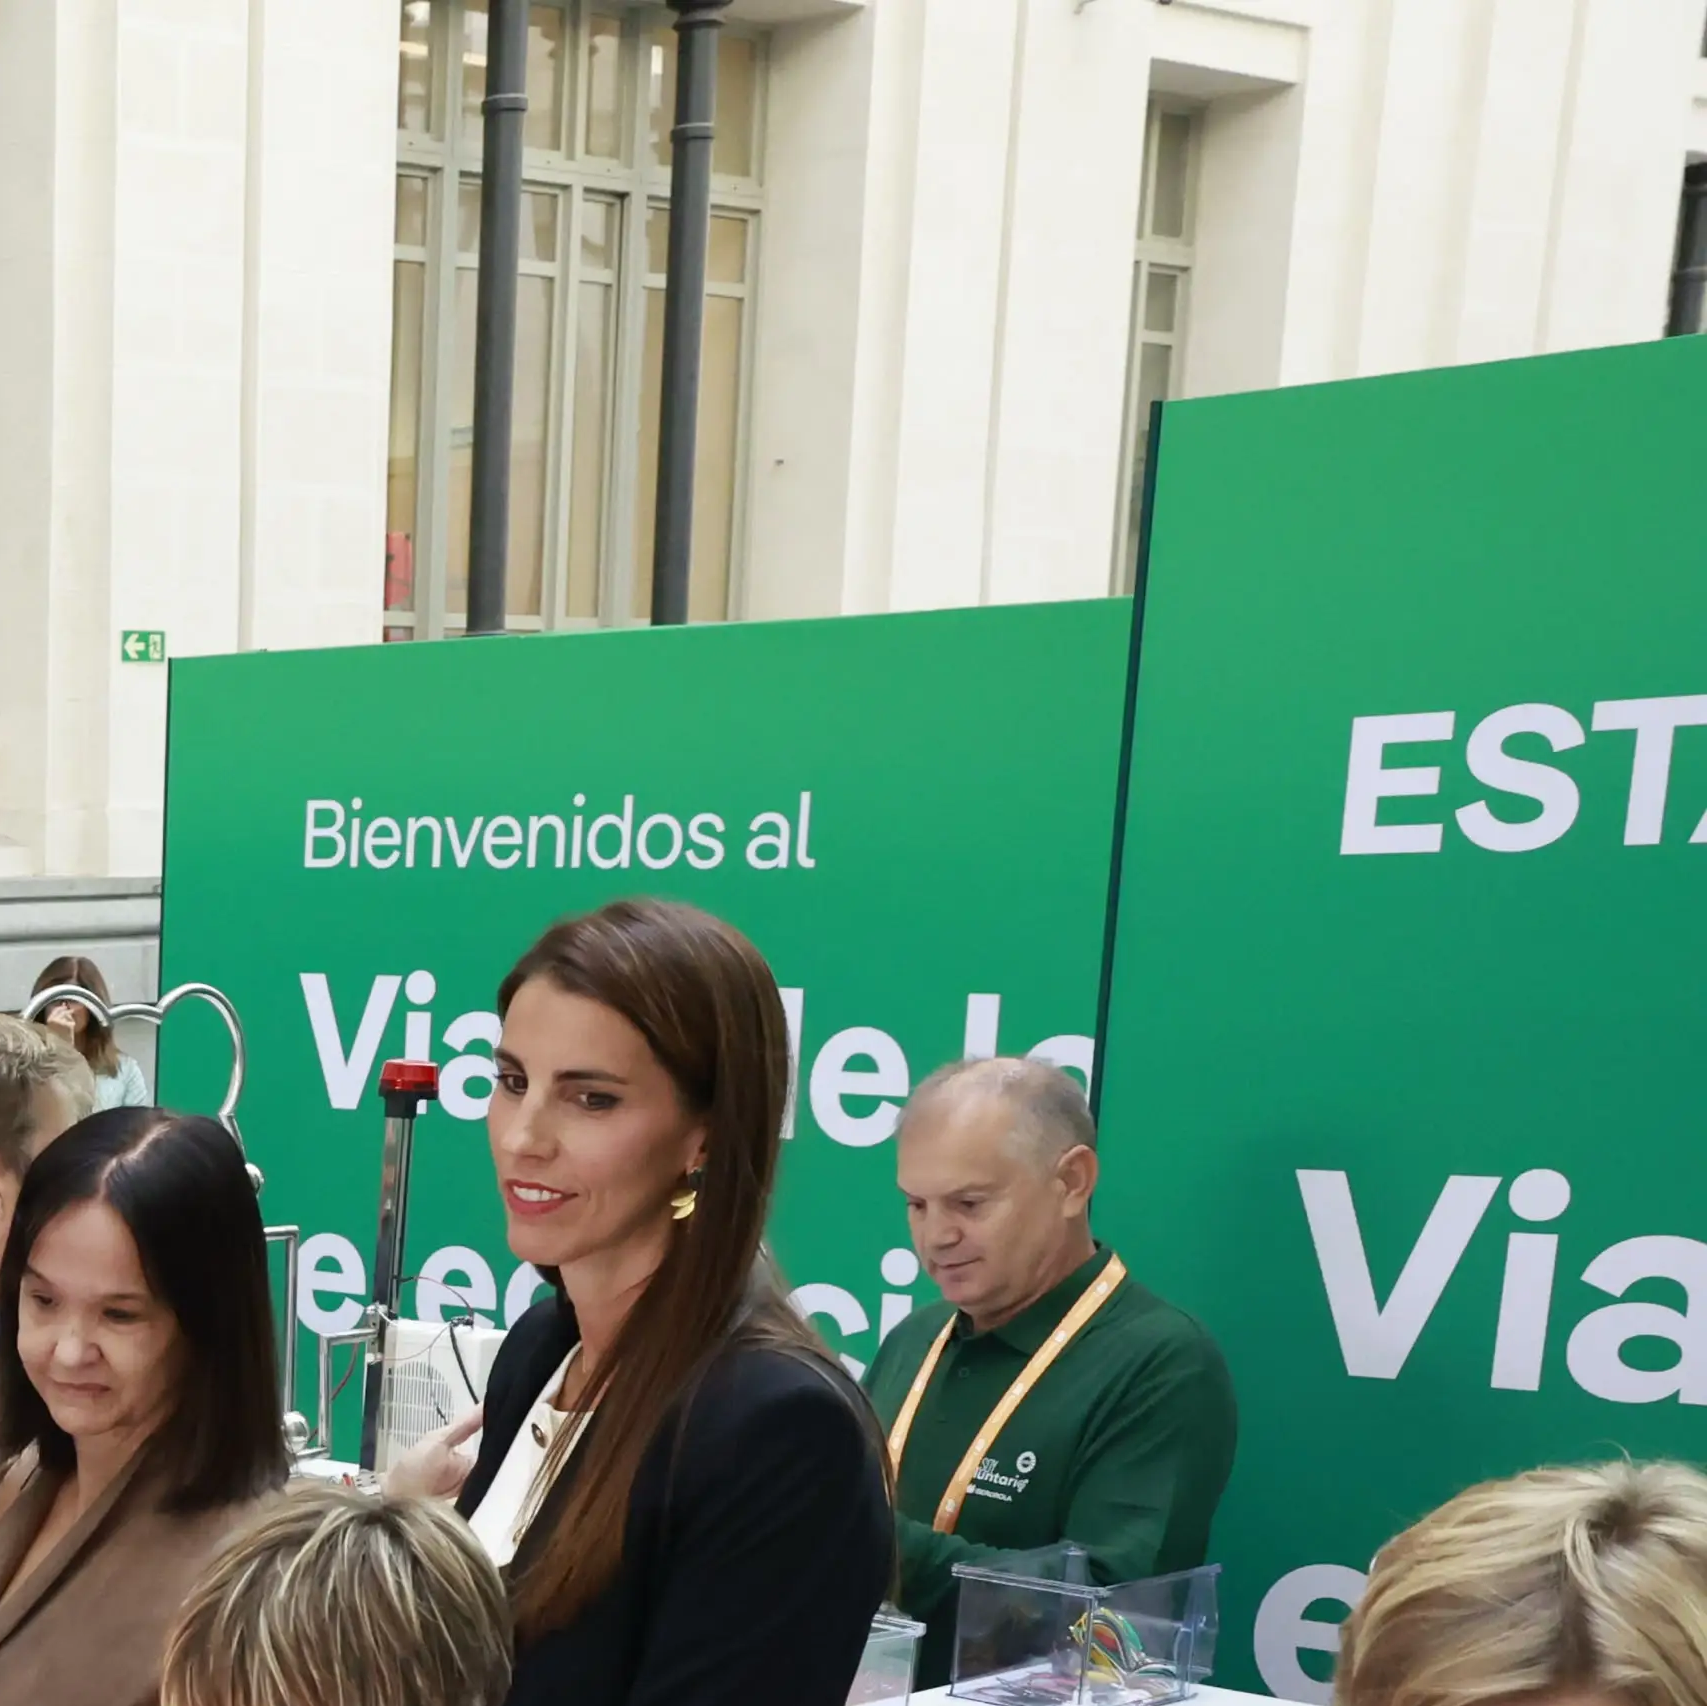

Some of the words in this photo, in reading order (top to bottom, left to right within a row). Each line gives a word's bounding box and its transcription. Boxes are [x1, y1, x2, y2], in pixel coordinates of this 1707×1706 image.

[303, 793, 726, 870] Bienvenidos
[745, 791, 816, 870] al
[1340, 694, 1707, 856] EST
